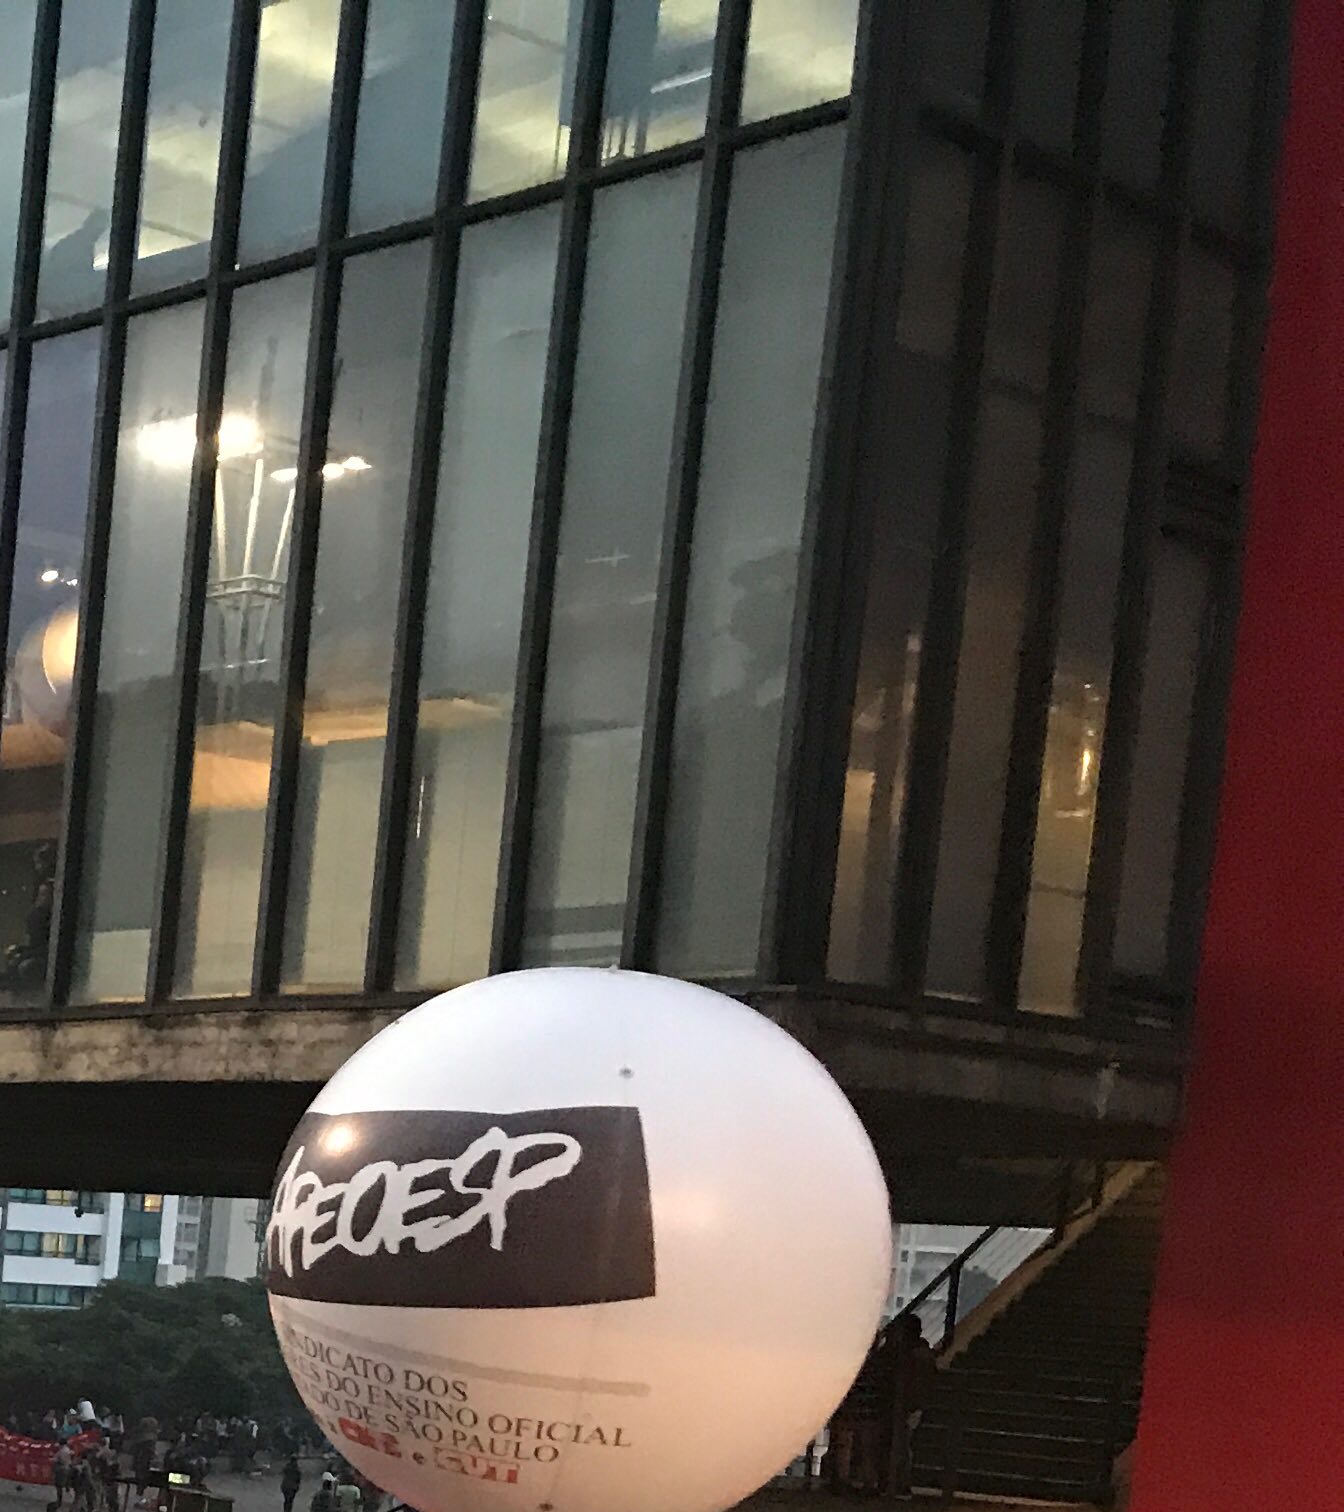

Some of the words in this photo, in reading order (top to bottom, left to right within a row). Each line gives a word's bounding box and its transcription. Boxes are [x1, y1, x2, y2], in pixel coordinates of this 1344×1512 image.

[327, 1371, 359, 1398] DO
[368, 1385, 478, 1429] ENSINO
[488, 1413, 632, 1448] OFICIAL
[404, 1370, 468, 1401] DOS
[345, 1401, 373, 1426] DE
[452, 1429, 560, 1464] PAULO
